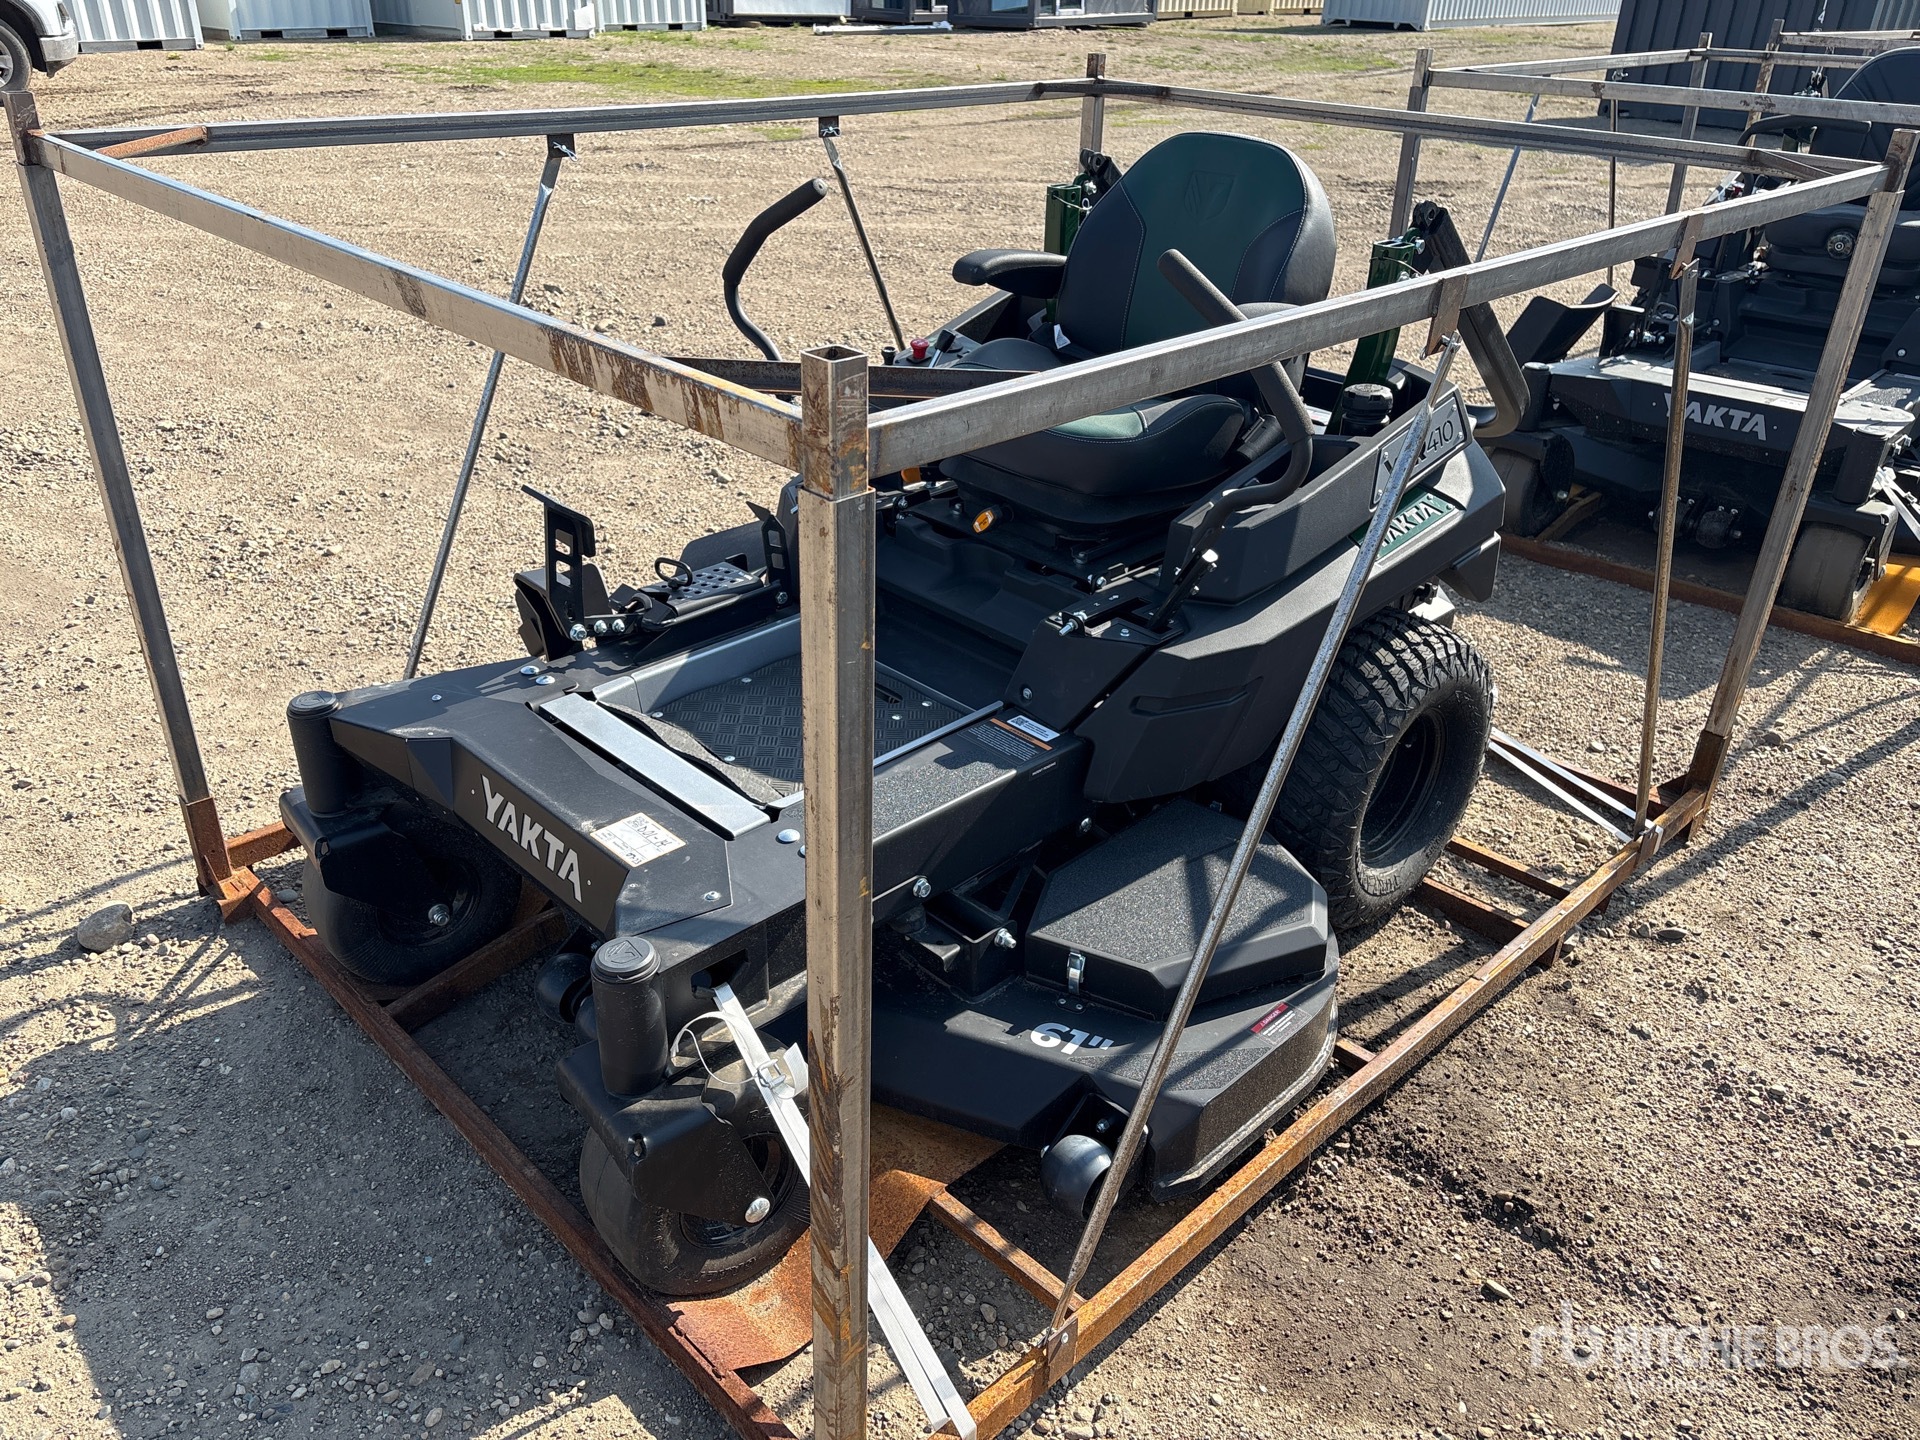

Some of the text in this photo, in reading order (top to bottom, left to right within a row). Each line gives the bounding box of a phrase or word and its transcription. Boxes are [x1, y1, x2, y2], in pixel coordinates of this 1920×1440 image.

[1382, 501, 1444, 547] AKTA
[480, 774, 583, 903] YAKTA
[1030, 1022, 1115, 1055] 61"
